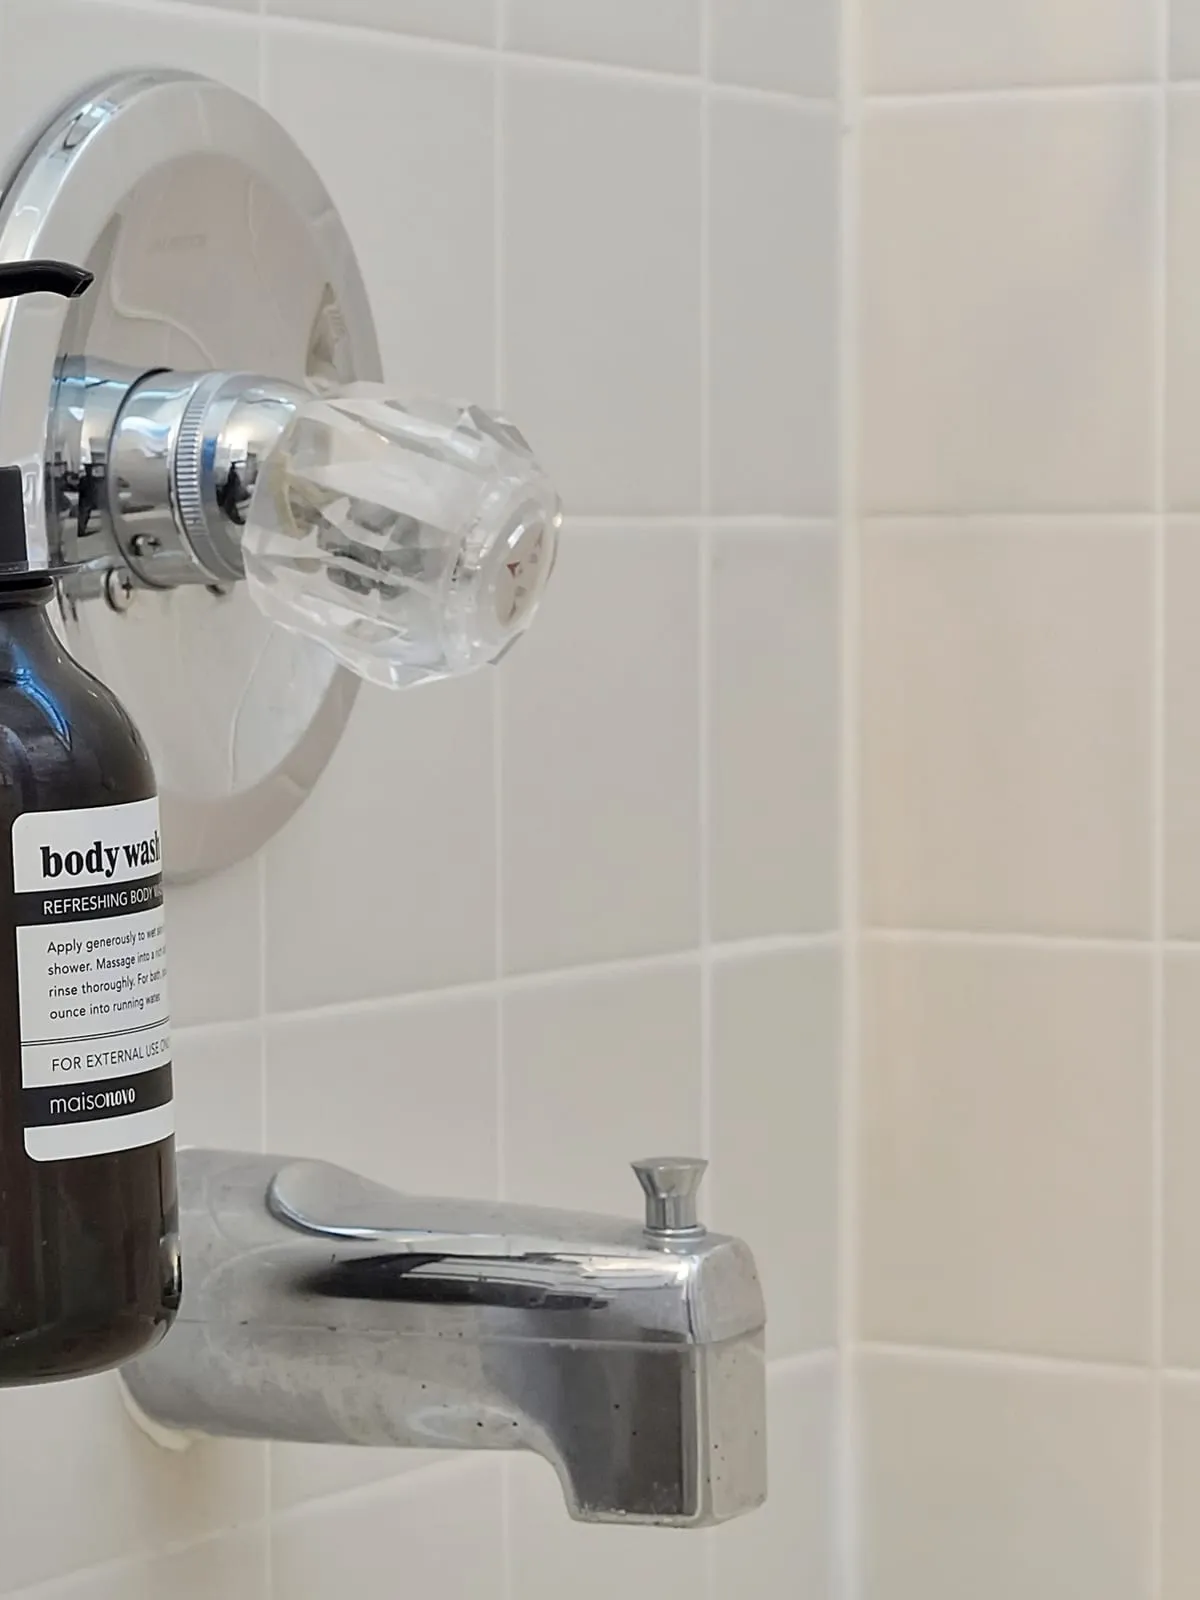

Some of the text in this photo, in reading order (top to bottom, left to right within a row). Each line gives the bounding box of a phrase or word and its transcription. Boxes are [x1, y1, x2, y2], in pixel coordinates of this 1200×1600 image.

[39, 829, 160, 879] body wash
[43, 891, 128, 915] REFRESHING
[130, 886, 153, 904] BODY
[47, 939, 83, 956] Apply
[86, 930, 137, 953] generously
[137, 931, 146, 941] to
[47, 962, 93, 976] shower.
[96, 953, 136, 969] Massage
[137, 951, 150, 964] into
[49, 984, 78, 998] rinse
[82, 974, 136, 992] thoroughly.
[137, 972, 149, 985] For
[49, 1007, 87, 1020] ounce
[89, 1002, 110, 1016] into
[113, 995, 144, 1011] running
[52, 1056, 82, 1072] FOR
[86, 1046, 144, 1069] EXTERNAL
[145, 1041, 159, 1057] USE
[50, 1087, 136, 1115] maisonovo
